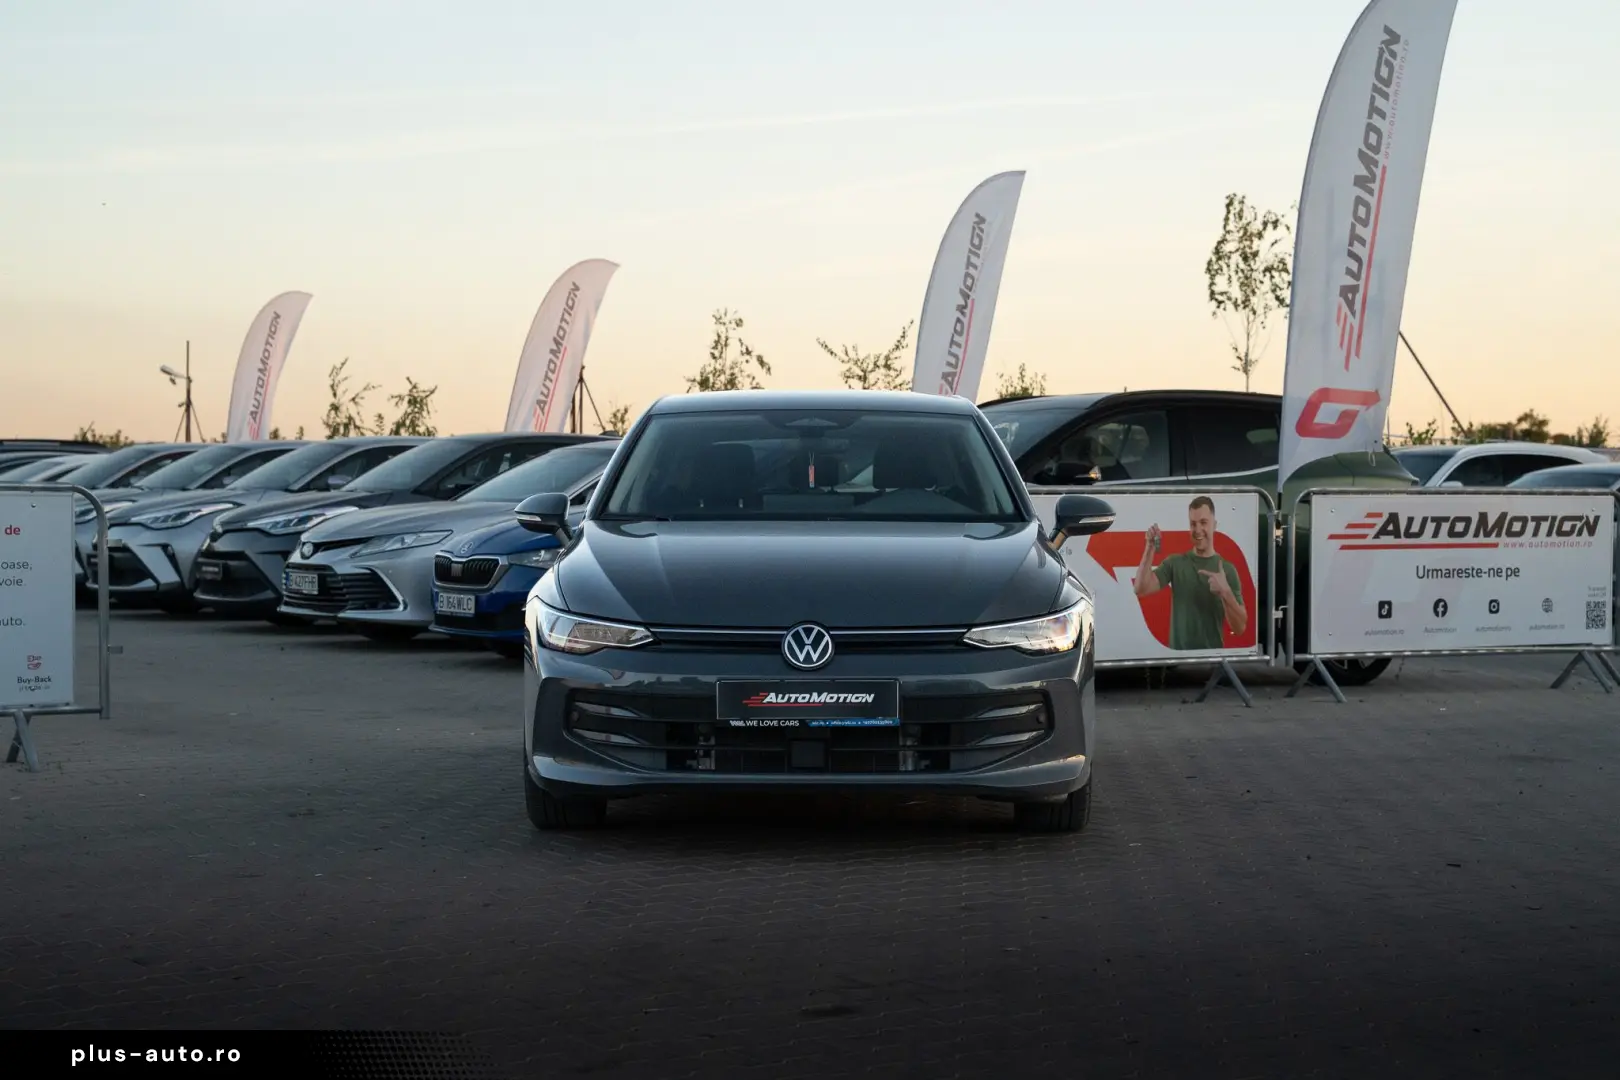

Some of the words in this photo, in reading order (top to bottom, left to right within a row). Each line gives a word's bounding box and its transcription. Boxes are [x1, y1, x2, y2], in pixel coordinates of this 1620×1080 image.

[4, 524, 21, 535] de
[1416, 565, 1503, 579] Urmareste-ne
[1506, 567, 1520, 580] pe
[17, 675, 52, 684] Buy-Back
